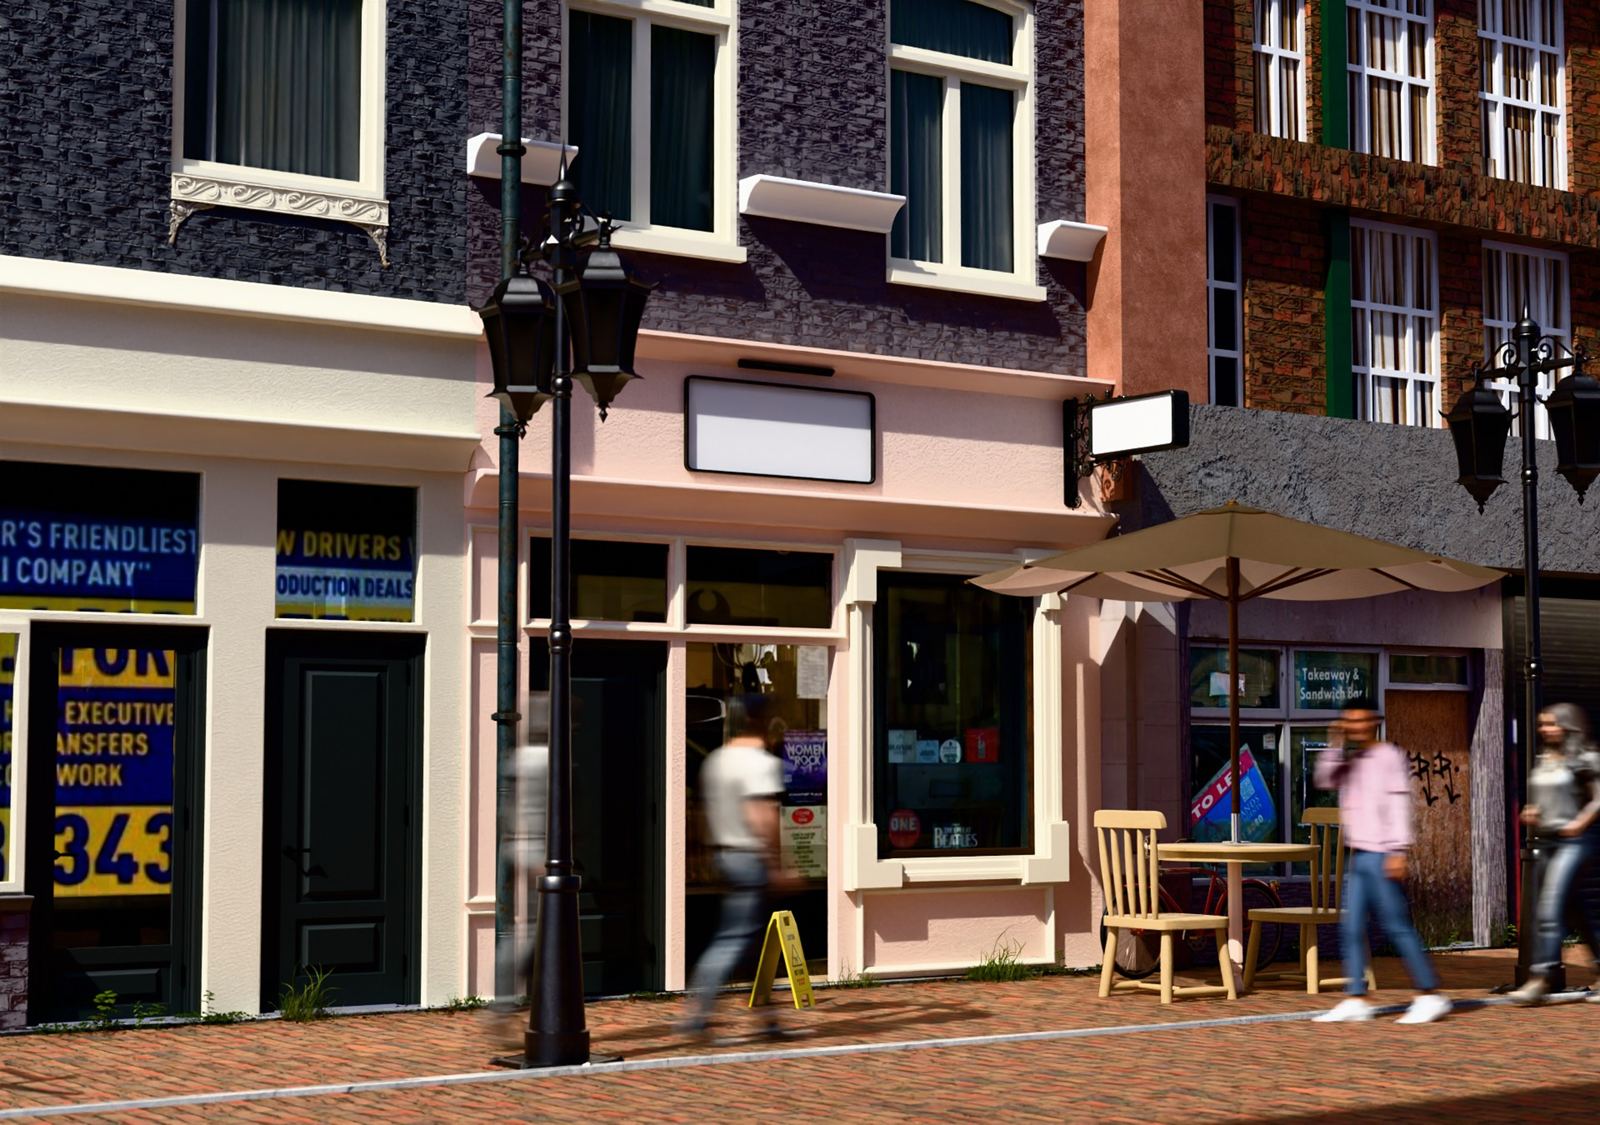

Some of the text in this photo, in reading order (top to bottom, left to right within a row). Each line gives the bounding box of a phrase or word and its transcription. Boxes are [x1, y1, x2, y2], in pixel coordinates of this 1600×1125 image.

[303, 530, 401, 561] DRIVERS
[364, 577, 413, 599] DEALS
[1302, 667, 1360, 683] Takeaway &
[1300, 686, 1345, 701] Sandwich
[65, 700, 174, 726] EXECUTIVE
[56, 763, 123, 787] WORK
[1192, 794, 1214, 818] TO
[890, 816, 917, 832] ONE
[933, 826, 979, 849] BEATLES
